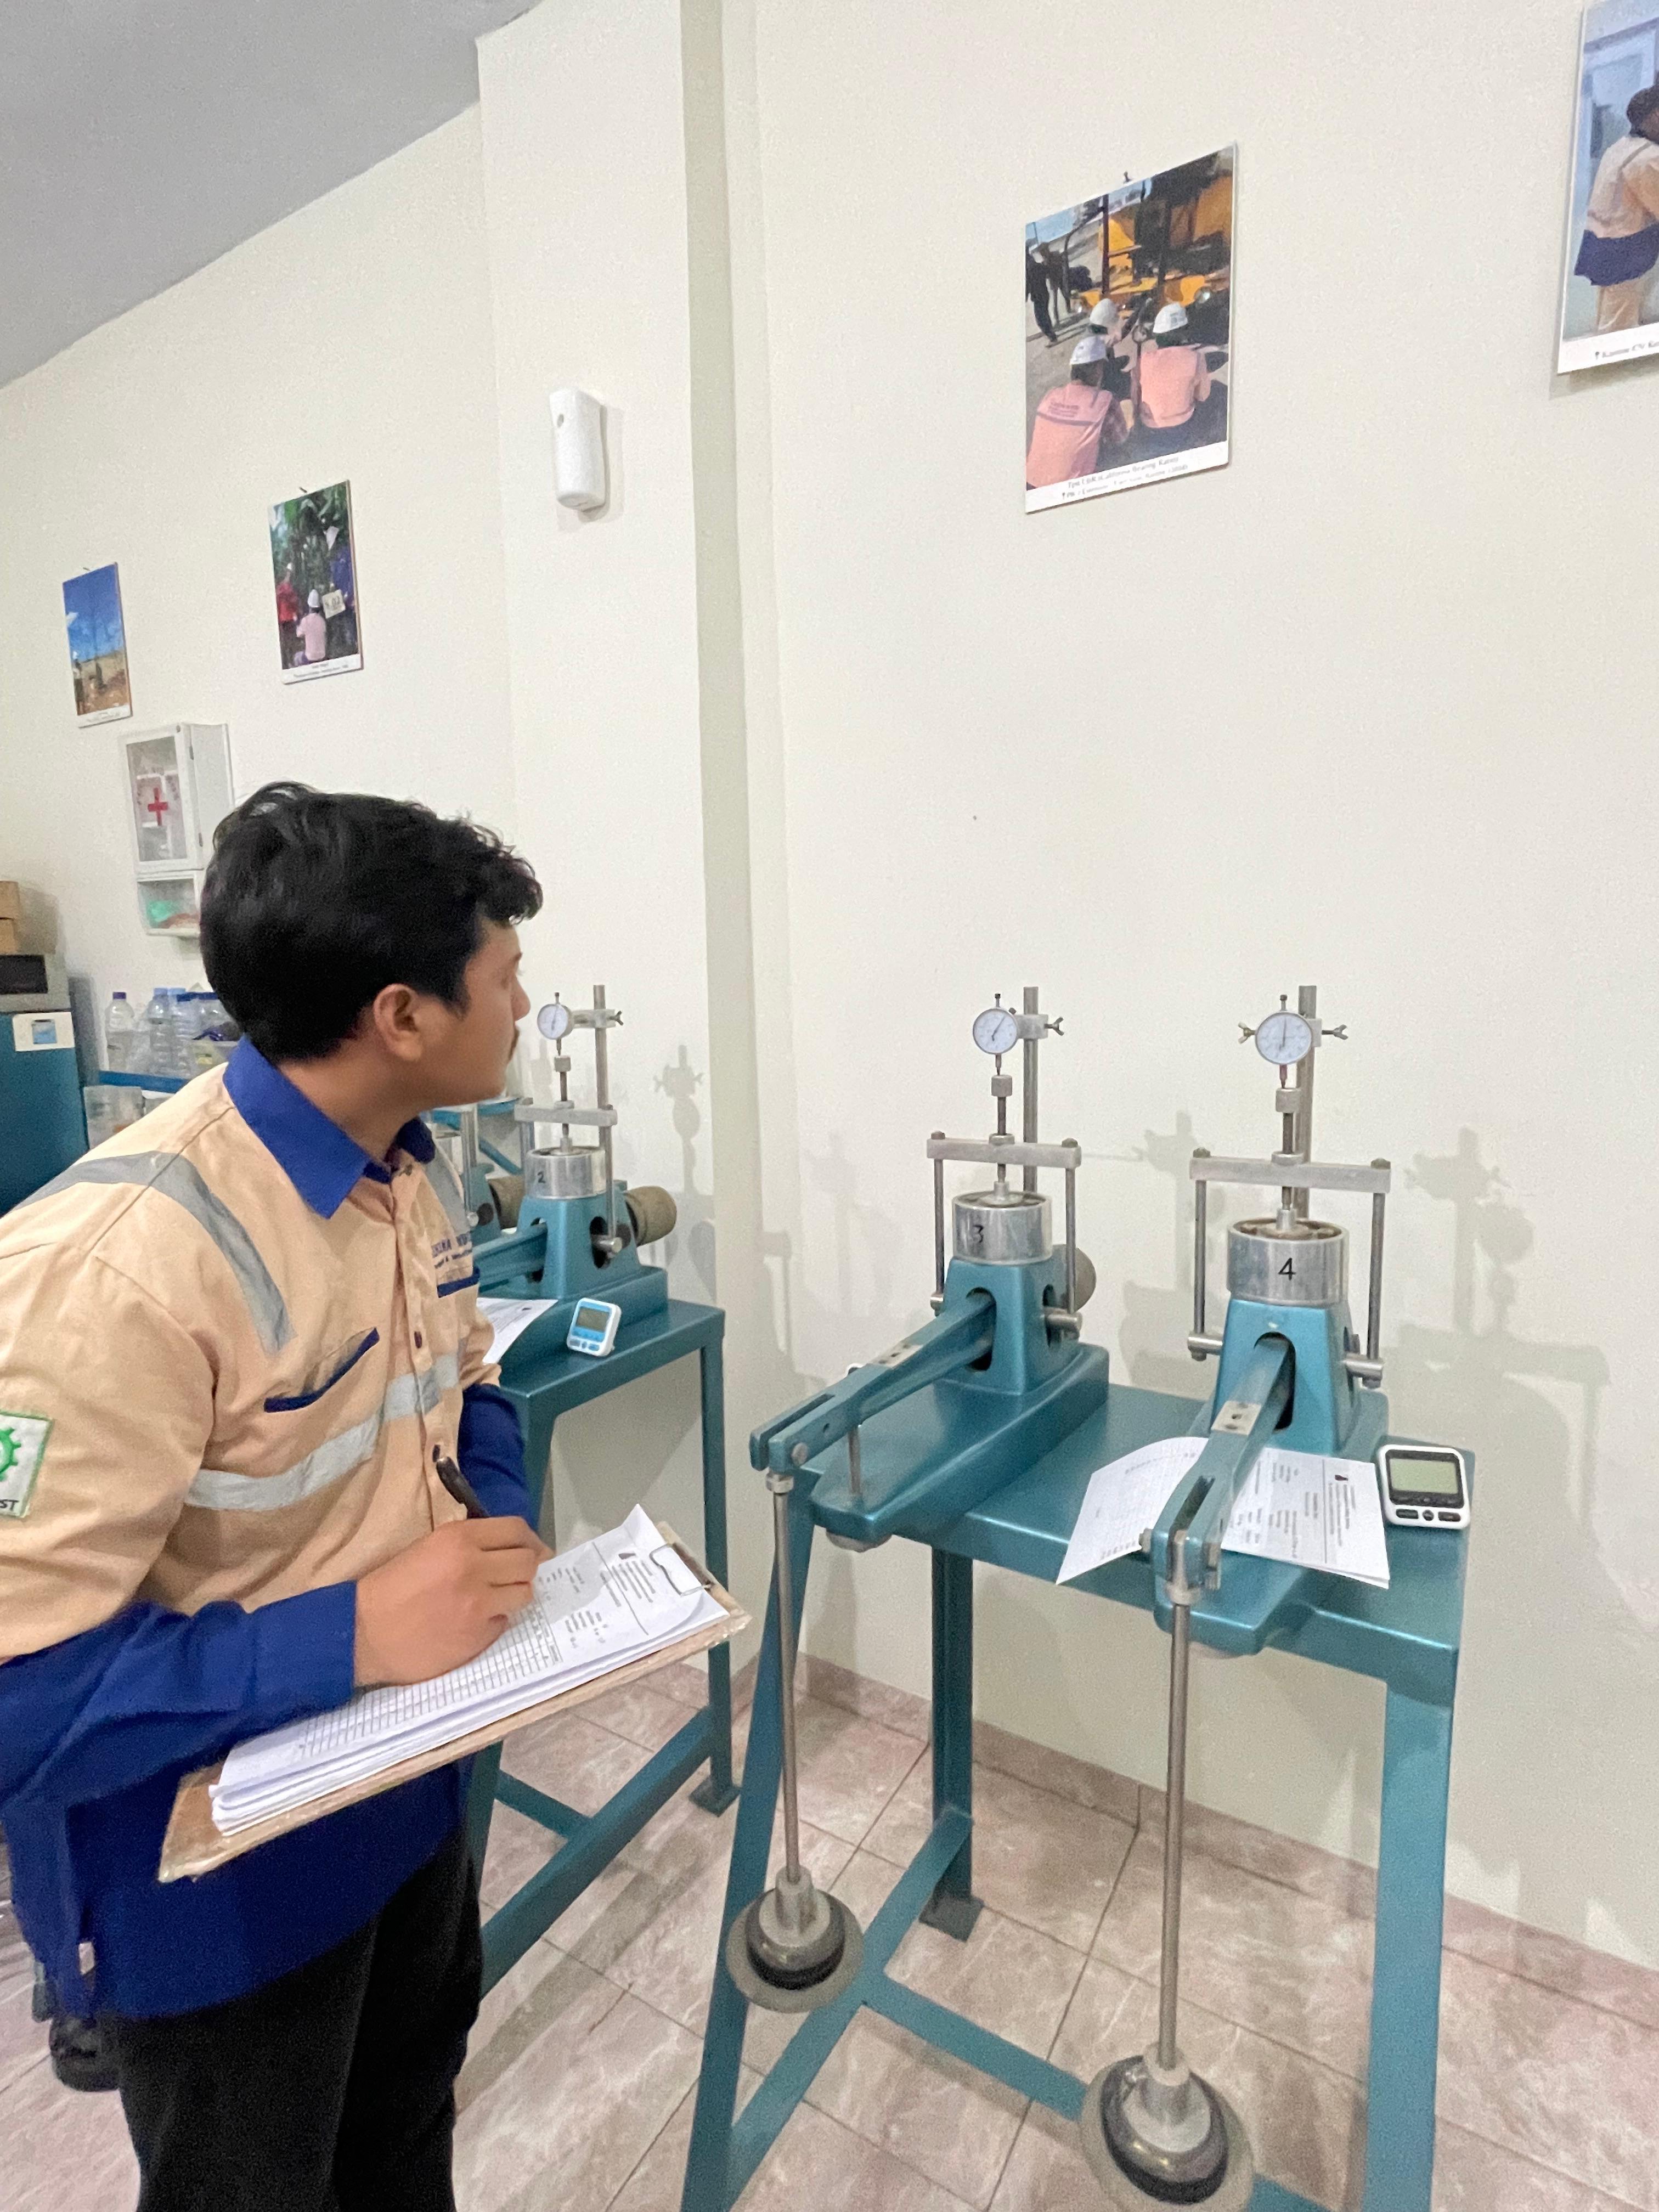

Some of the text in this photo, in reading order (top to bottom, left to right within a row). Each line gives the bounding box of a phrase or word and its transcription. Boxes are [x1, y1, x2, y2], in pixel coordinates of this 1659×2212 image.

[538, 1171, 546, 1183] 2
[973, 1224, 984, 1243] 3
[1278, 1257, 1296, 1281] 4
[0, 1499, 19, 1511] ST
